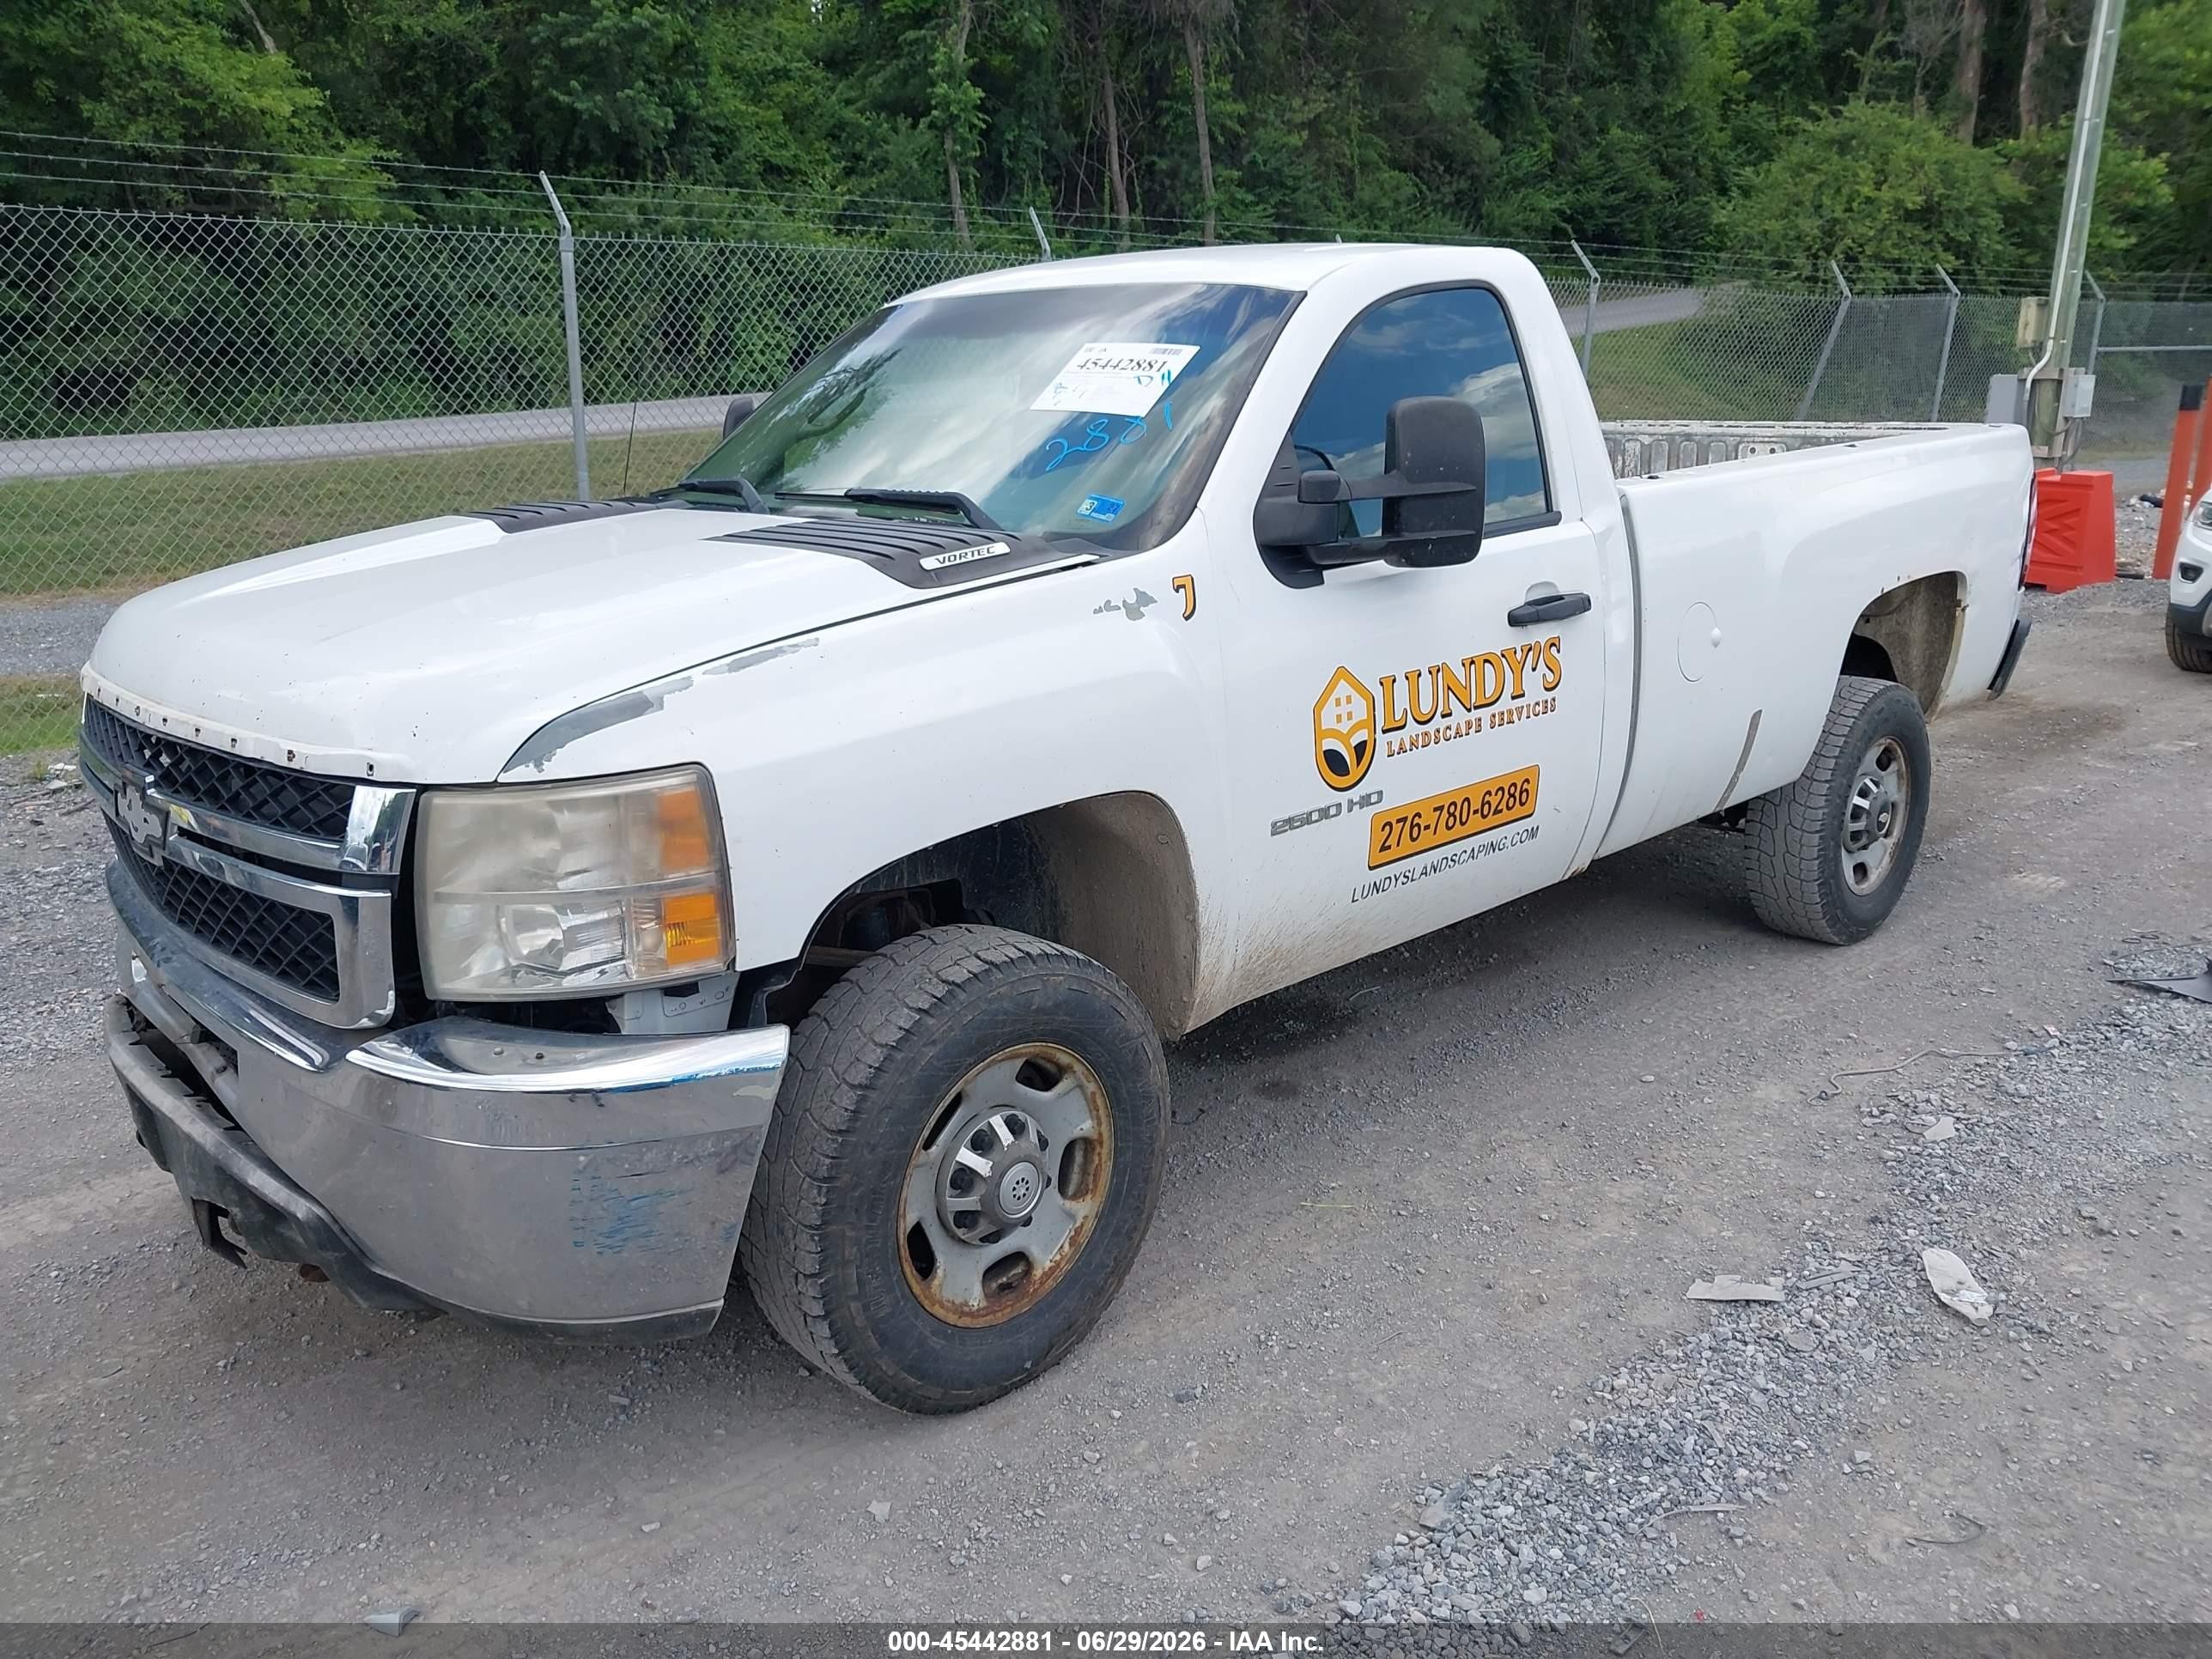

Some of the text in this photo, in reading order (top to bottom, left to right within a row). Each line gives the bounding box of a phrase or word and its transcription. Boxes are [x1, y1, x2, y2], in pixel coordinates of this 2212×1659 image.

[1077, 358, 1168, 373] 45442881
[935, 545, 995, 566] VORTEC
[1379, 635, 1562, 734] LUNDY'S
[1386, 696, 1557, 757] LANDSCAPE SERVICES
[1270, 789, 1383, 837] 2500 HD
[1378, 777, 1531, 854] 276-780-6286
[1351, 824, 1540, 903] LUNDYSLANDSCAPING.COM
